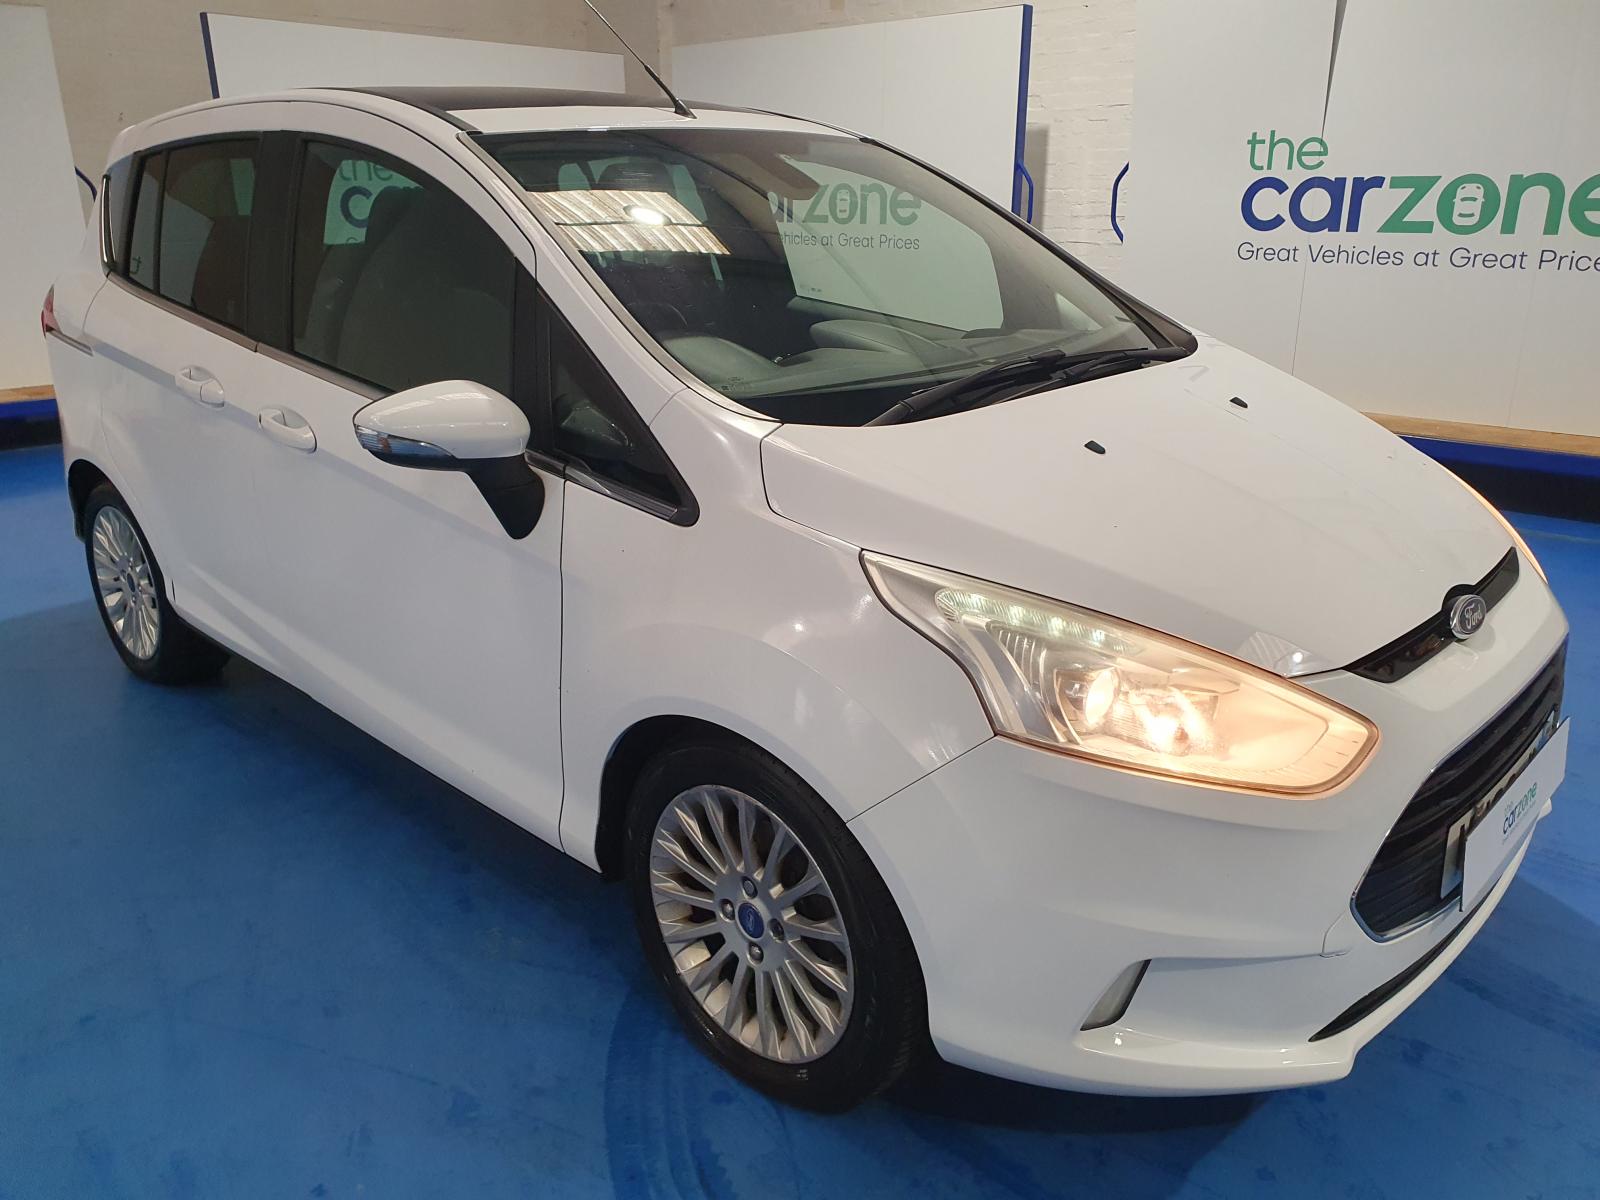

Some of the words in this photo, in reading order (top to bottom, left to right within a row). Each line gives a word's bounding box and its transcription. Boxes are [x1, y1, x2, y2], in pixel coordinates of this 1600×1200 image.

[1246, 130, 1329, 171] the
[820, 234, 834, 247] at
[838, 232, 875, 249] Great
[879, 236, 920, 250] Prices
[1236, 241, 1300, 263] Great
[1307, 243, 1405, 267] Vehicles
[1412, 248, 1441, 268] at
[1449, 246, 1529, 271] Great
[1464, 602, 1484, 630] Ford
[1502, 782, 1537, 835] carzone
